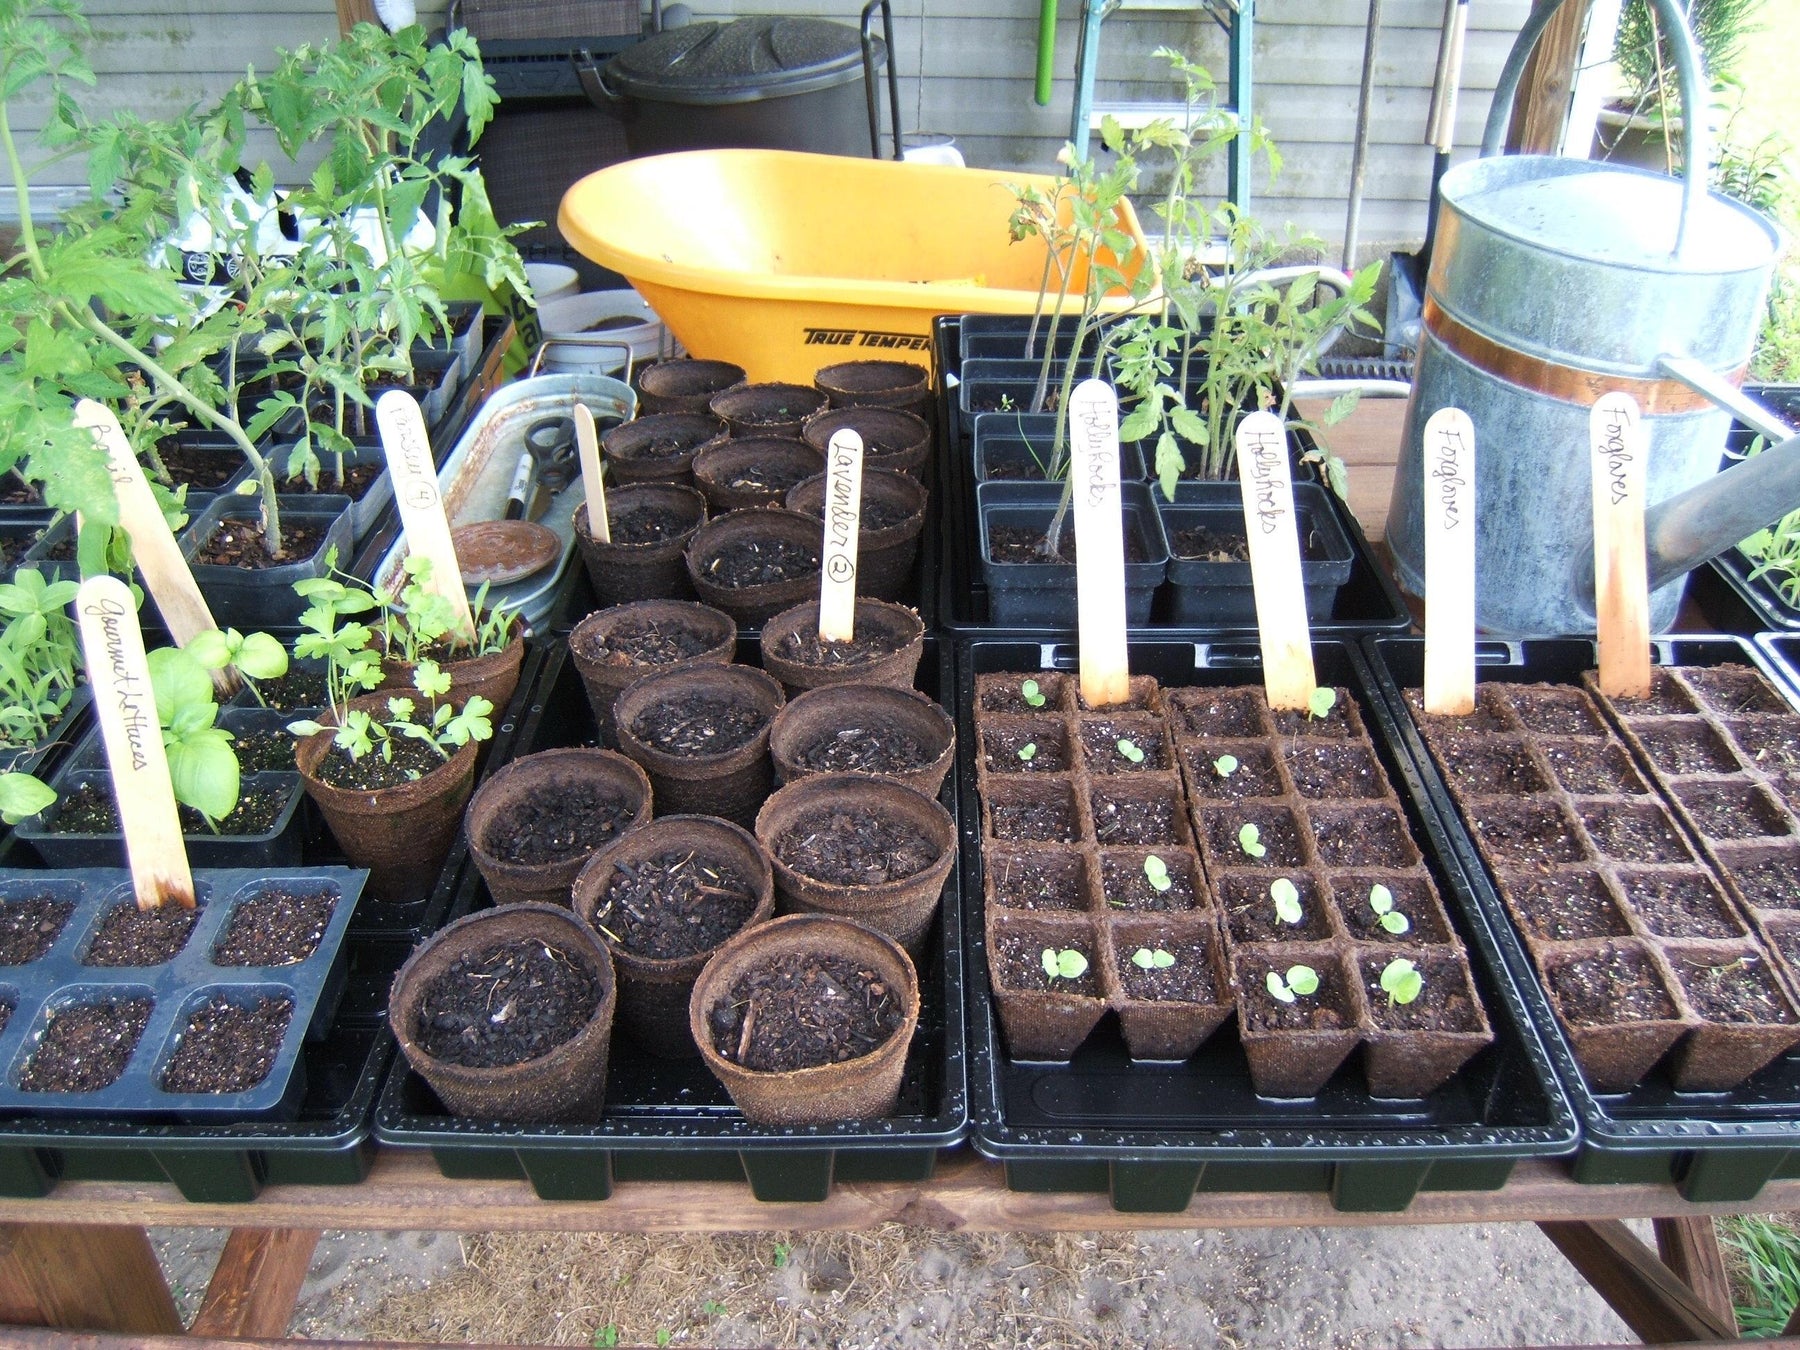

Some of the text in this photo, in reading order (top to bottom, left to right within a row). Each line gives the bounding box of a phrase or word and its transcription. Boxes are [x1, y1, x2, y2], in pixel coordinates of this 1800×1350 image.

[803, 327, 857, 345] TRUE
[830, 442, 858, 548] Lavender
[1432, 429, 1466, 530] Foxgloves
[1598, 408, 1633, 505] Foxgloves
